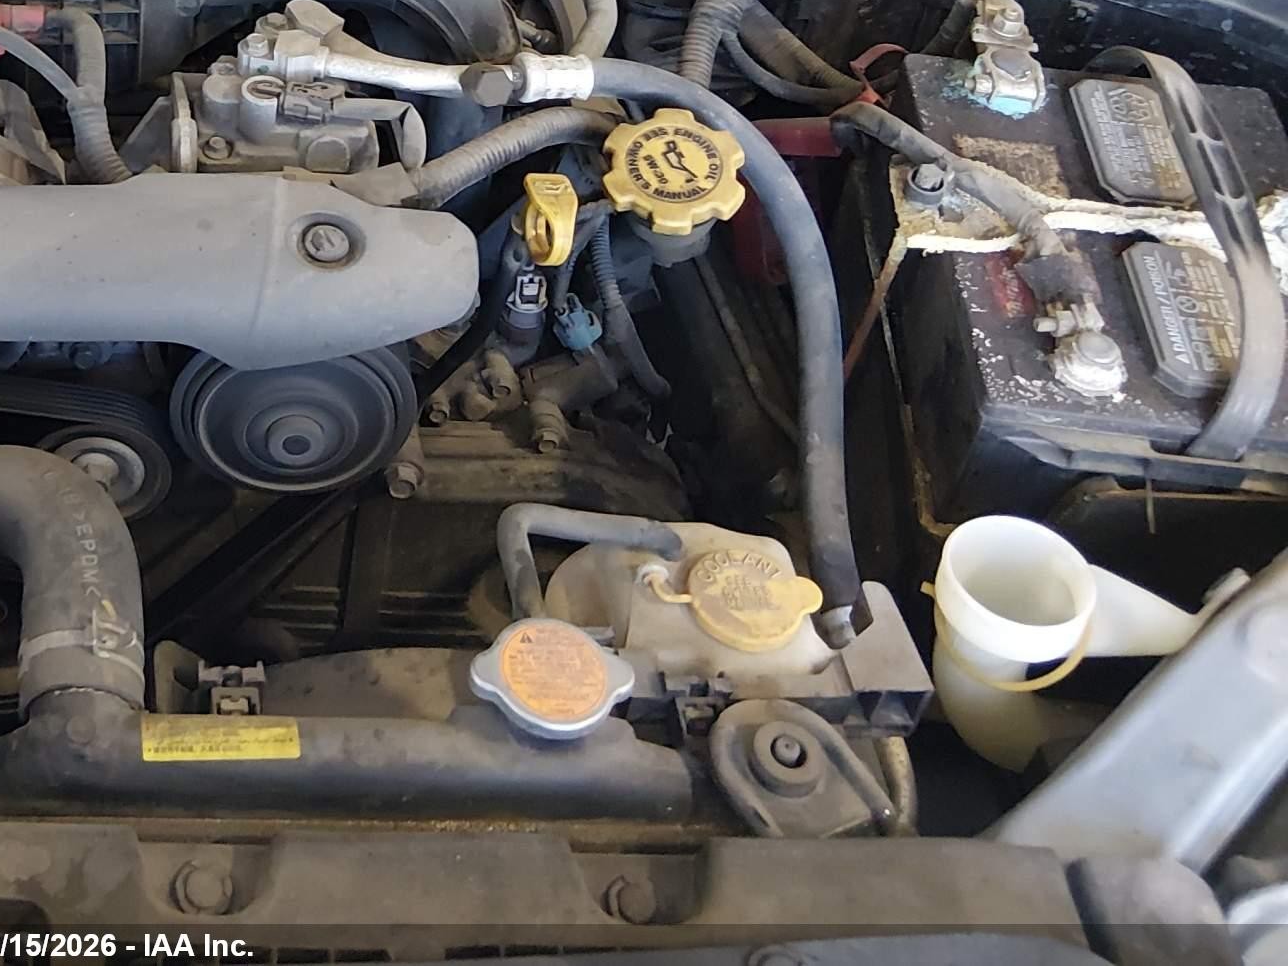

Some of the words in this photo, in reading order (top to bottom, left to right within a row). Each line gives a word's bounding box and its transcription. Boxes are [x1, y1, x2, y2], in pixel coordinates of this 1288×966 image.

[673, 128, 717, 160] ENGINE
[704, 163, 720, 181] OIL
[652, 185, 707, 200] MANUAL
